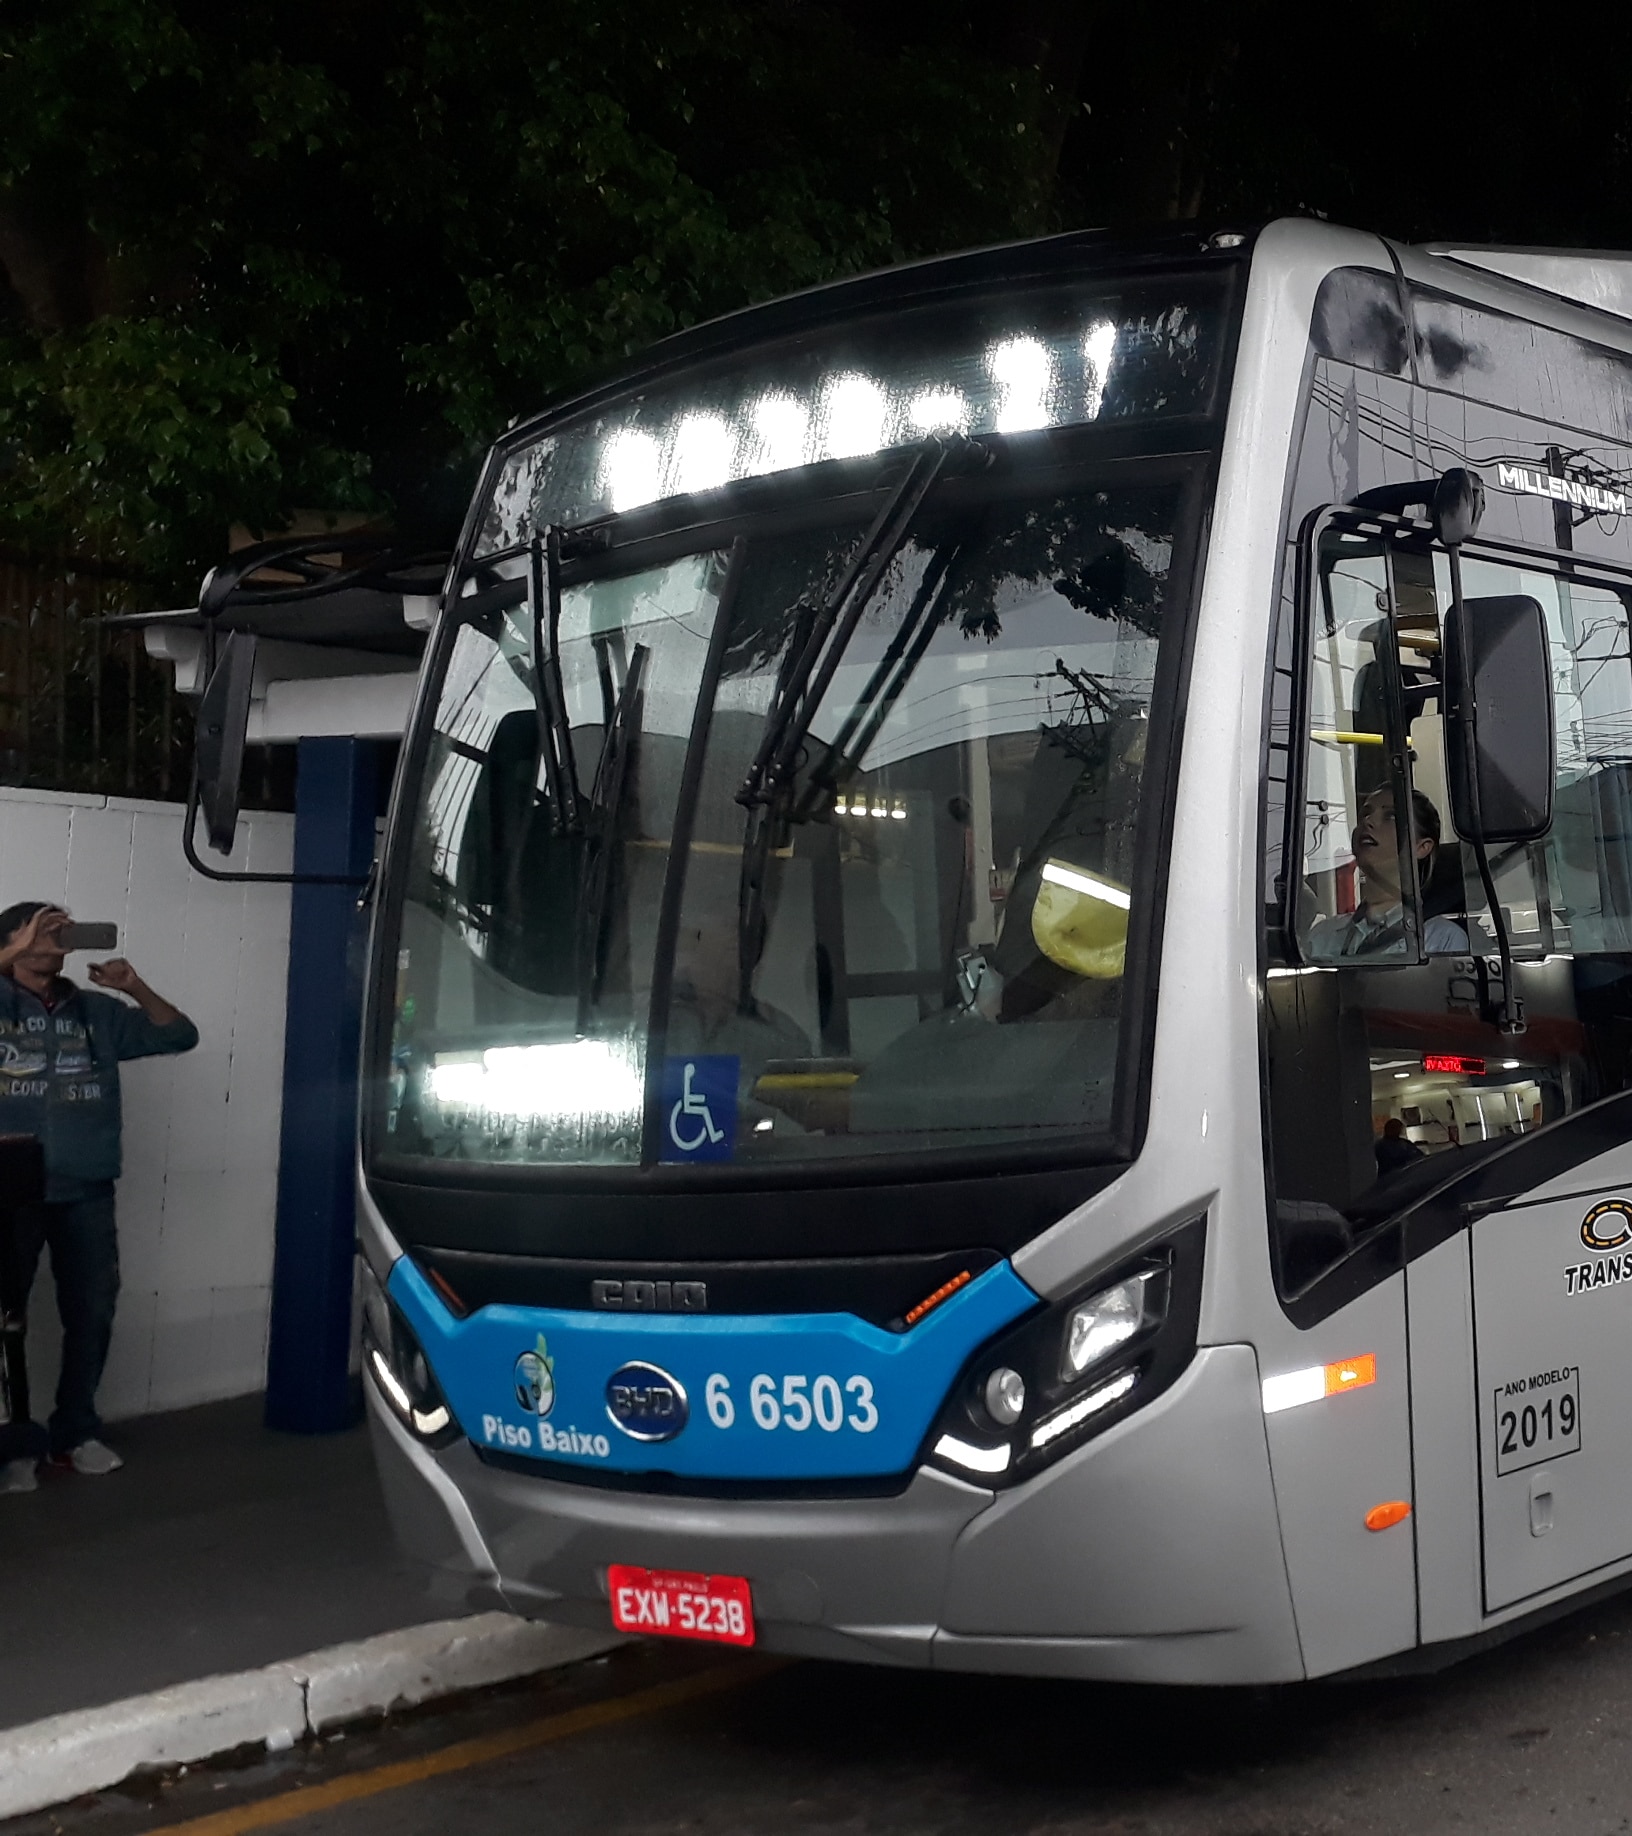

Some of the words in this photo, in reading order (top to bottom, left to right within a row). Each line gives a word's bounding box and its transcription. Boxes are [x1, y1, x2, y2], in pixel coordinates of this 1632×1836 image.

[1499, 463, 1627, 515] MILLENNIUM
[611, 1384, 674, 1417] BYD
[705, 1373, 736, 1430] 6
[750, 1373, 879, 1433] 6503
[1504, 1379, 1527, 1397] ANO
[1528, 1366, 1571, 1389] MODELO
[482, 1414, 532, 1449] Piso
[537, 1420, 611, 1458] Baixo
[1500, 1393, 1576, 1455] 2019
